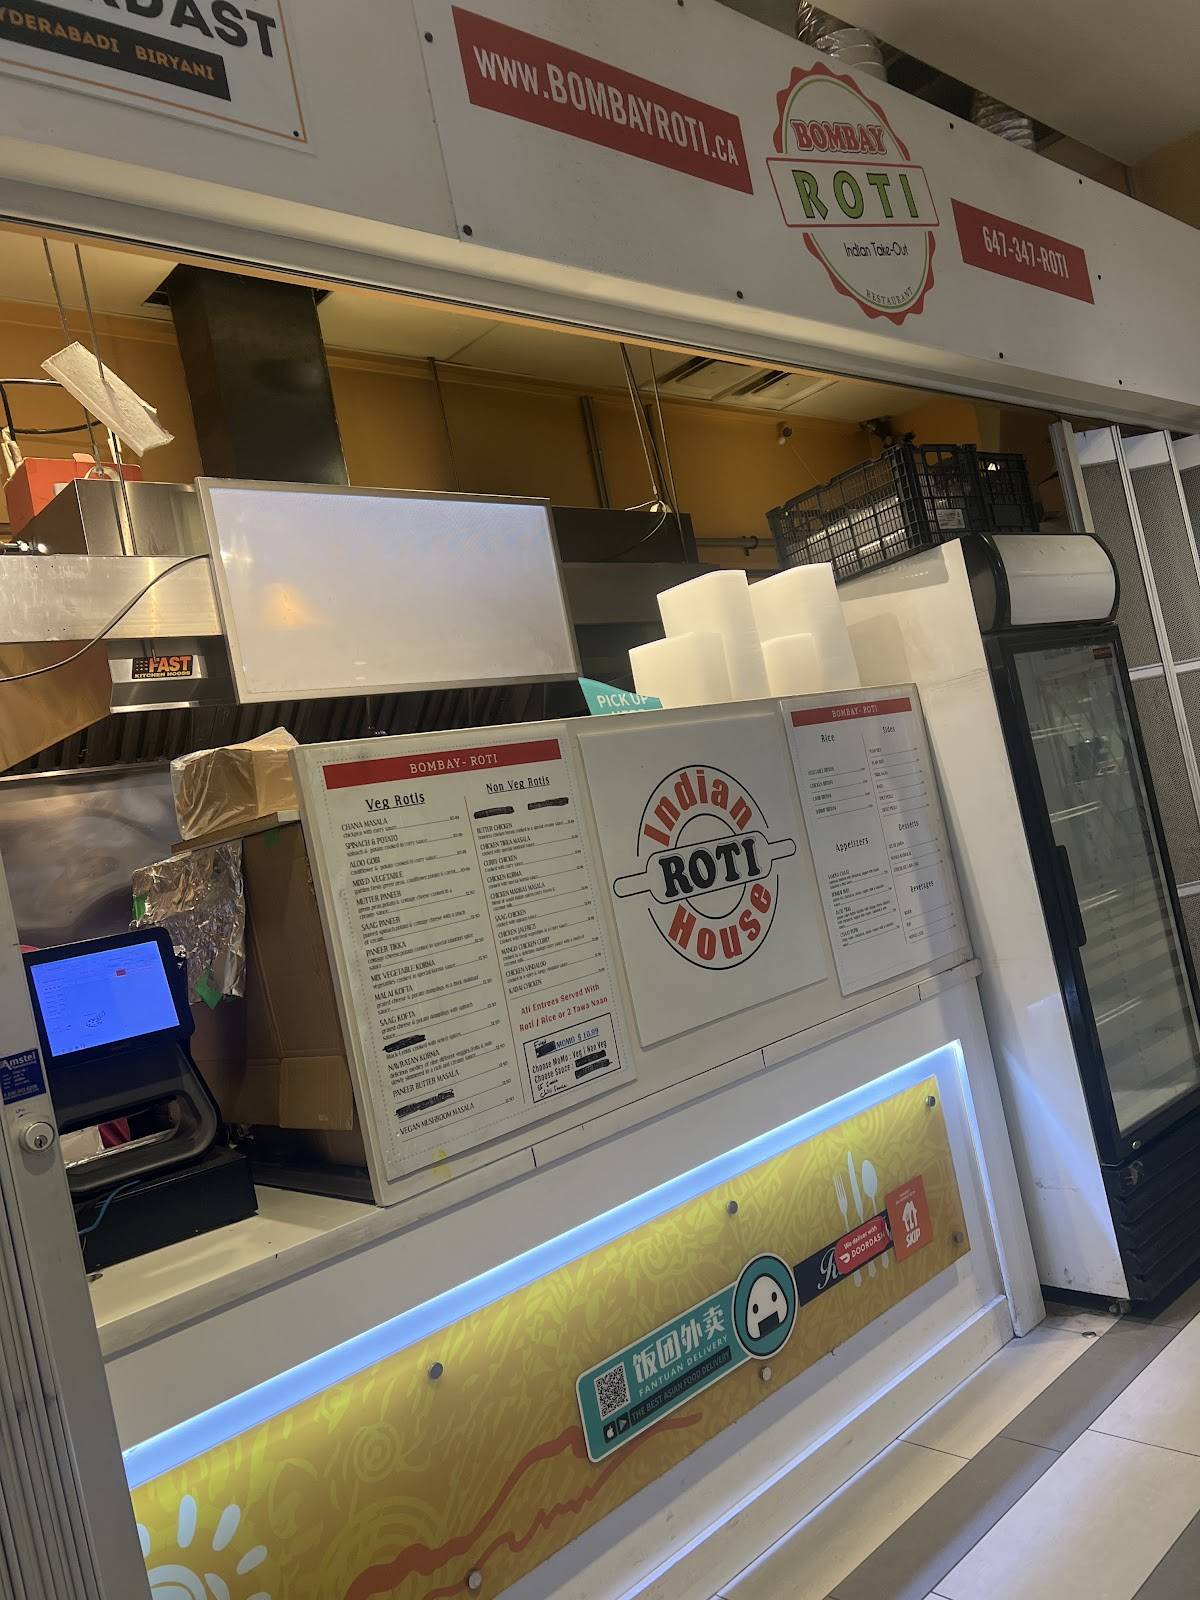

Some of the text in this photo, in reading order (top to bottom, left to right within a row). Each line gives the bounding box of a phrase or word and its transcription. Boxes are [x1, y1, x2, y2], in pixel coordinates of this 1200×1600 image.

[134, 44, 215, 81] BIRYANI
[472, 45, 740, 167] WWW.BOMBAYROTI.CA
[790, 119, 888, 156] BOMBAY
[791, 168, 920, 220] ROTI
[843, 241, 909, 257] Indian Take-Out
[982, 225, 1069, 279] 647-347-ROTI
[866, 286, 914, 305] RESTAURANT
[149, 655, 192, 673] FAST
[596, 693, 630, 708] PICK
[821, 734, 835, 743] Rice
[470, 753, 498, 766] ROTI
[485, 775, 550, 794] Non Veg Rotis
[364, 791, 425, 811] Veg Rotis
[644, 769, 753, 847] Indian
[340, 817, 388, 831] CHANA MASALA
[898, 820, 920, 831] Desserts
[344, 838, 370, 849] SPINACH
[376, 834, 398, 844] POTATO
[835, 837, 869, 853] Appetizers
[348, 858, 365, 868] ALOO
[658, 837, 761, 898] ROTI
[351, 877, 370, 887] MIXED
[370, 870, 403, 883] VEGETABLE
[379, 889, 401, 900] PANEER
[360, 915, 400, 931] SAAG PANEER
[668, 883, 772, 961] House
[365, 945, 387, 957] PANEER
[520, 983, 599, 1015] All Entrees Served With
[379, 1015, 396, 1026] SAAG
[519, 1020, 534, 1032] Roti
[540, 1012, 556, 1024] Rice
[557, 1009, 565, 1019] or
[566, 1007, 571, 1016] 2
[572, 1001, 590, 1014] Tawa
[590, 995, 608, 1007] Naan
[555, 1035, 575, 1048] MOMO
[2, 1051, 36, 1070] Amstel
[531, 1059, 552, 1074] Choose
[533, 1069, 554, 1084] Choose
[554, 1062, 571, 1076] Sauce
[392, 1084, 414, 1098] PANEER
[415, 1076, 436, 1090] BUTTER
[436, 1068, 459, 1082] MASALA
[400, 1121, 420, 1136] VEGAN
[451, 1101, 474, 1116] MASALA
[905, 1227, 921, 1248] SKIP
[632, 1304, 726, 1384] 饭团外卖
[639, 1335, 728, 1398] FANTUAN DELIVERY
[631, 1407, 646, 1421] THE
[662, 1382, 682, 1402] ASIAN
[682, 1370, 701, 1390] FOOD
[701, 1351, 730, 1376] DELIVERY
